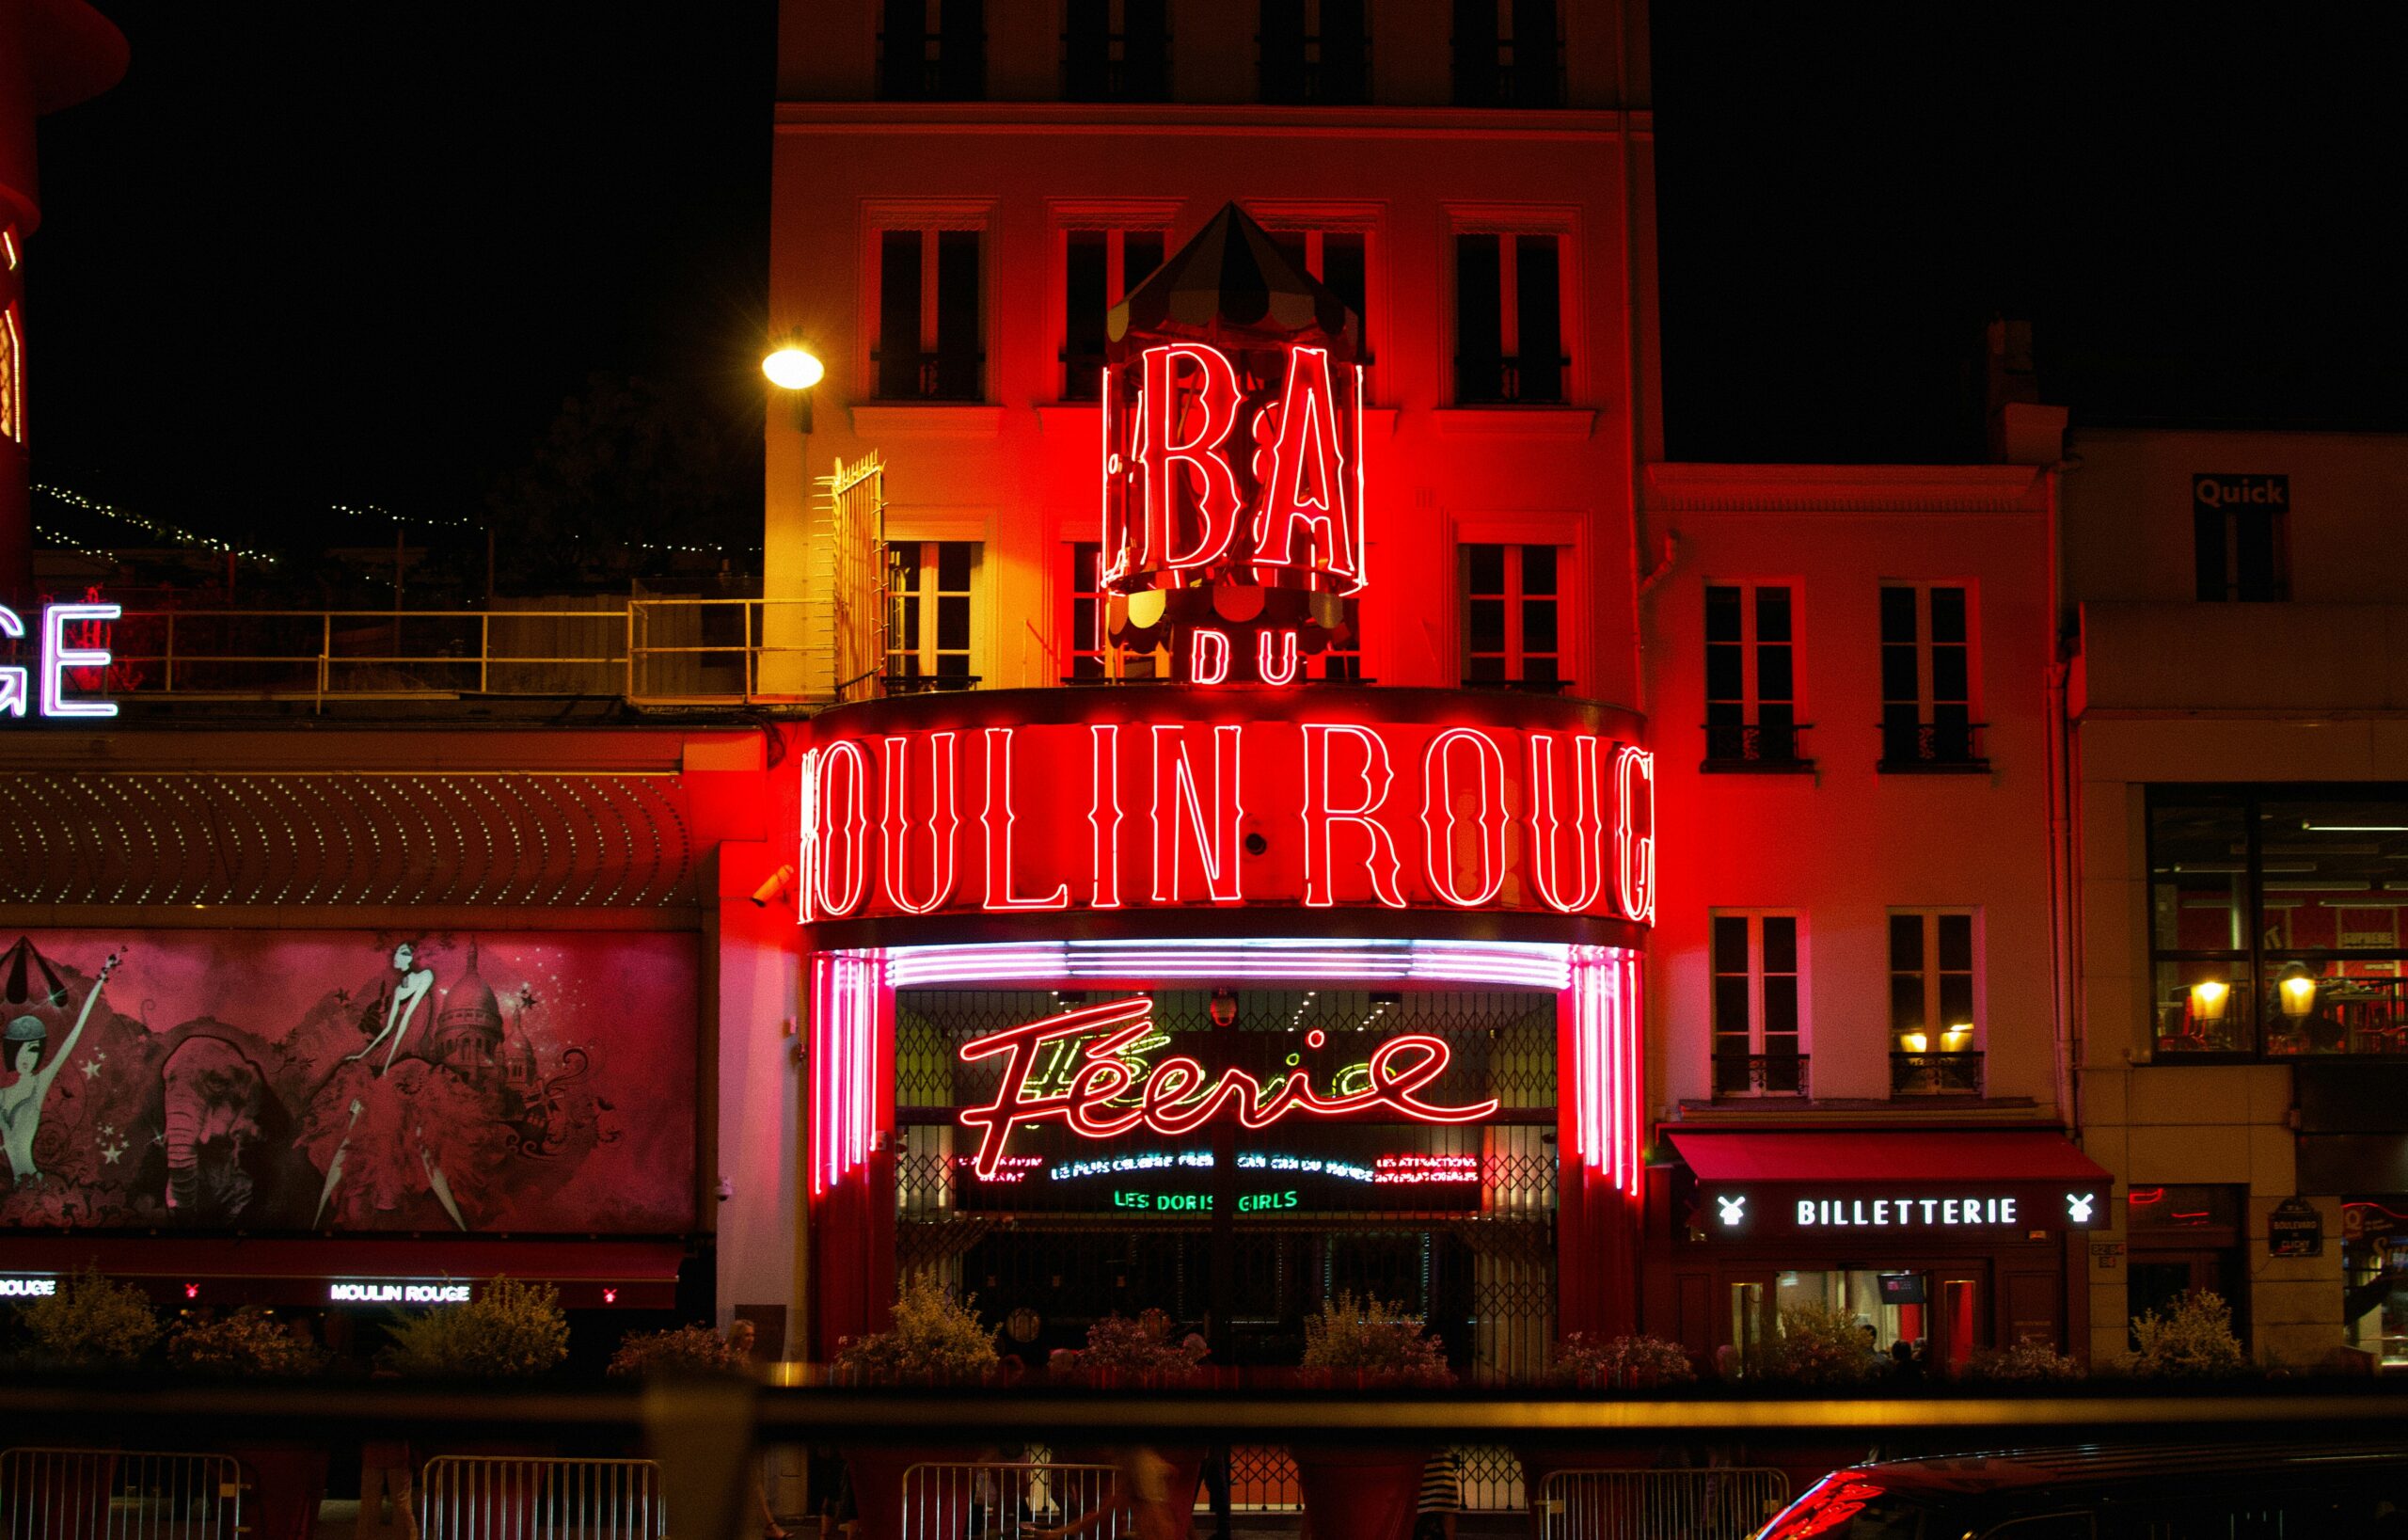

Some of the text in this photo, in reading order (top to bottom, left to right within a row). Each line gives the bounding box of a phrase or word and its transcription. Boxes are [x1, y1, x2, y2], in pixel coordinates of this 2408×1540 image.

[2196, 478, 2284, 508] Quick
[0, 605, 121, 717] E
[1192, 629, 1298, 687] DU
[798, 723, 1656, 928] OULIN ROUG
[959, 995, 1500, 1180] Féerie
[1115, 1190, 1299, 1212] LES DORIS GIRLS
[1798, 1198, 2018, 1227] BILLETTERIE
[331, 1285, 470, 1302] MOULIN ROUGE
